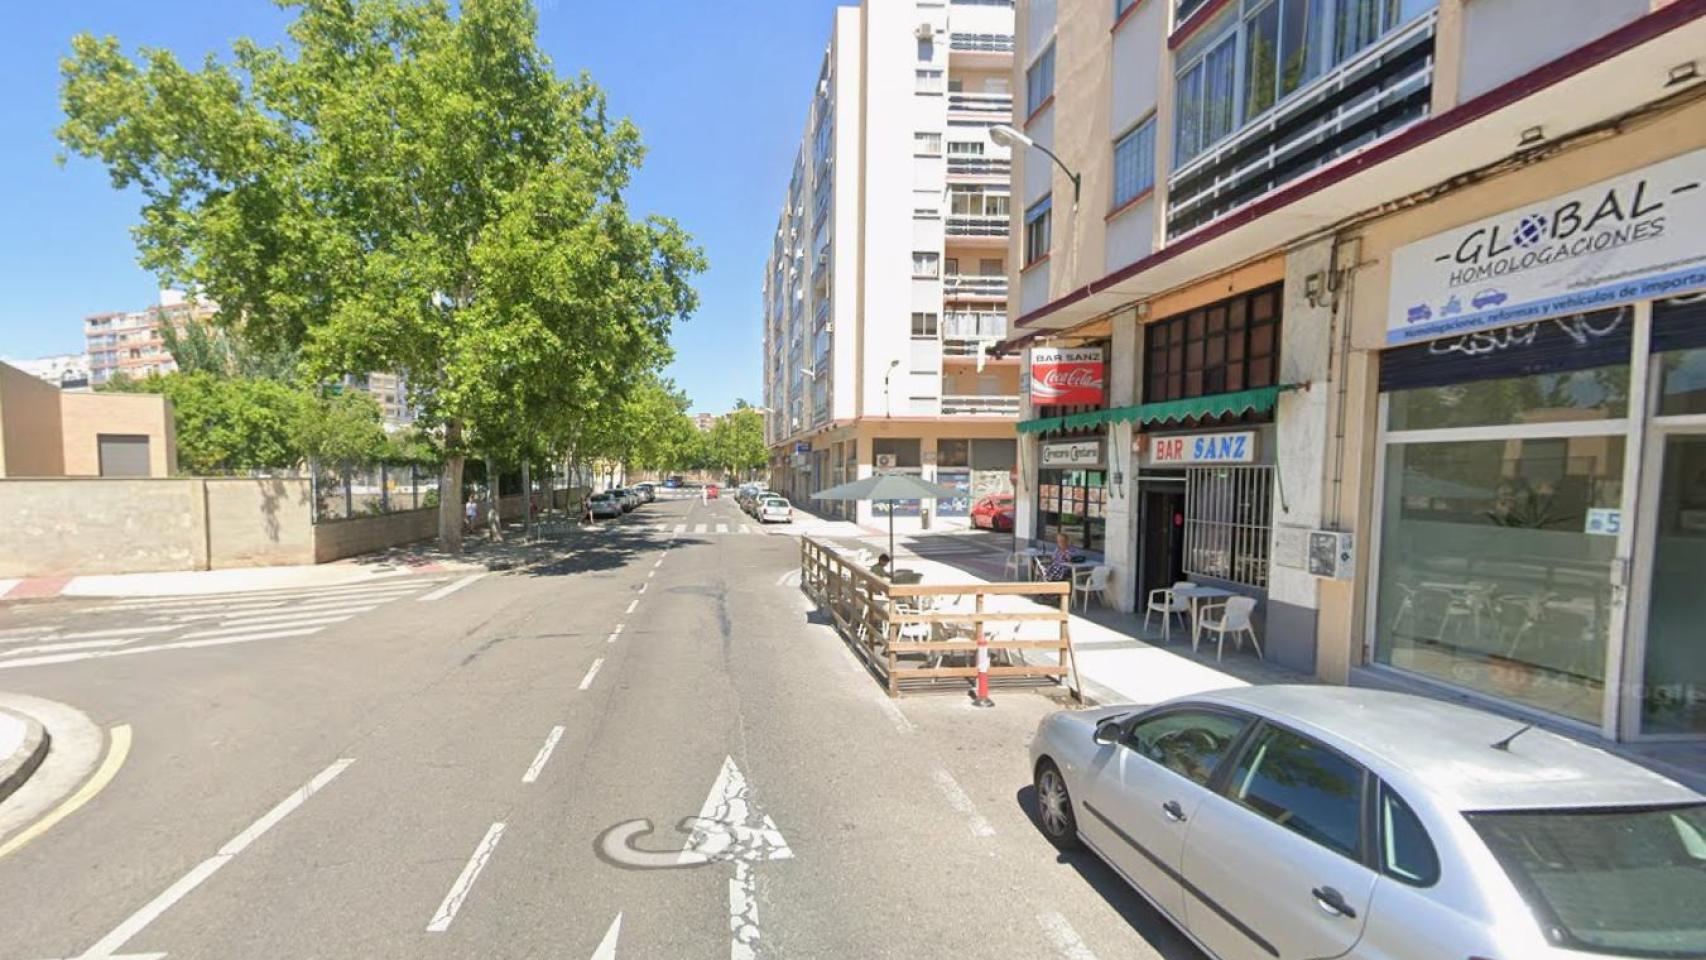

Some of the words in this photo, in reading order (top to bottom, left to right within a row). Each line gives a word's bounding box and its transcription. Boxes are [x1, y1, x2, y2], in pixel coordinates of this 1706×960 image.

[1449, 216, 1666, 287] HOMOLOGACIONES
[1487, 304, 1539, 323] reformas
[1618, 285, 1639, 299] de
[1036, 353, 1062, 362] BAR
[1065, 352, 1101, 361] SANZ
[1156, 440, 1183, 460] BAR
[1194, 436, 1247, 459] SANZ
[1604, 513, 1621, 533] 5
